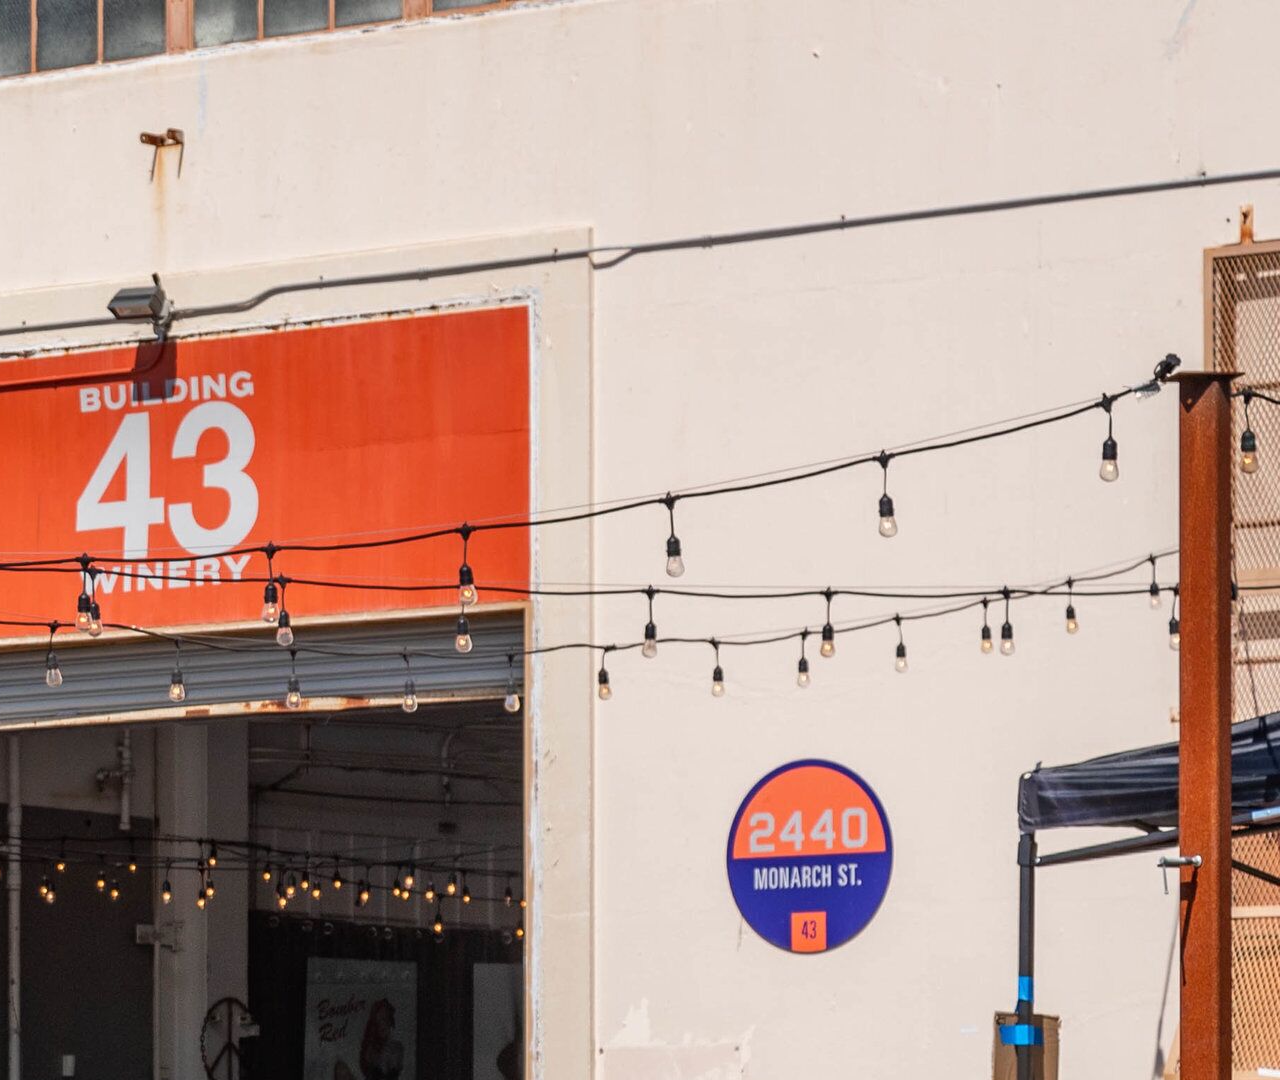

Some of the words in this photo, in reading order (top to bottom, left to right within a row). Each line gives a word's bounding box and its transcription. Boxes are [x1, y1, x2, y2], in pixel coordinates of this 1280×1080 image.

[79, 371, 255, 413] BUILDING
[75, 400, 259, 562] 43
[80, 555, 251, 595] WINERY
[749, 807, 868, 853] 2440
[754, 864, 832, 890] MONARCH
[837, 863, 862, 887] ST.
[801, 920, 817, 939] 43
